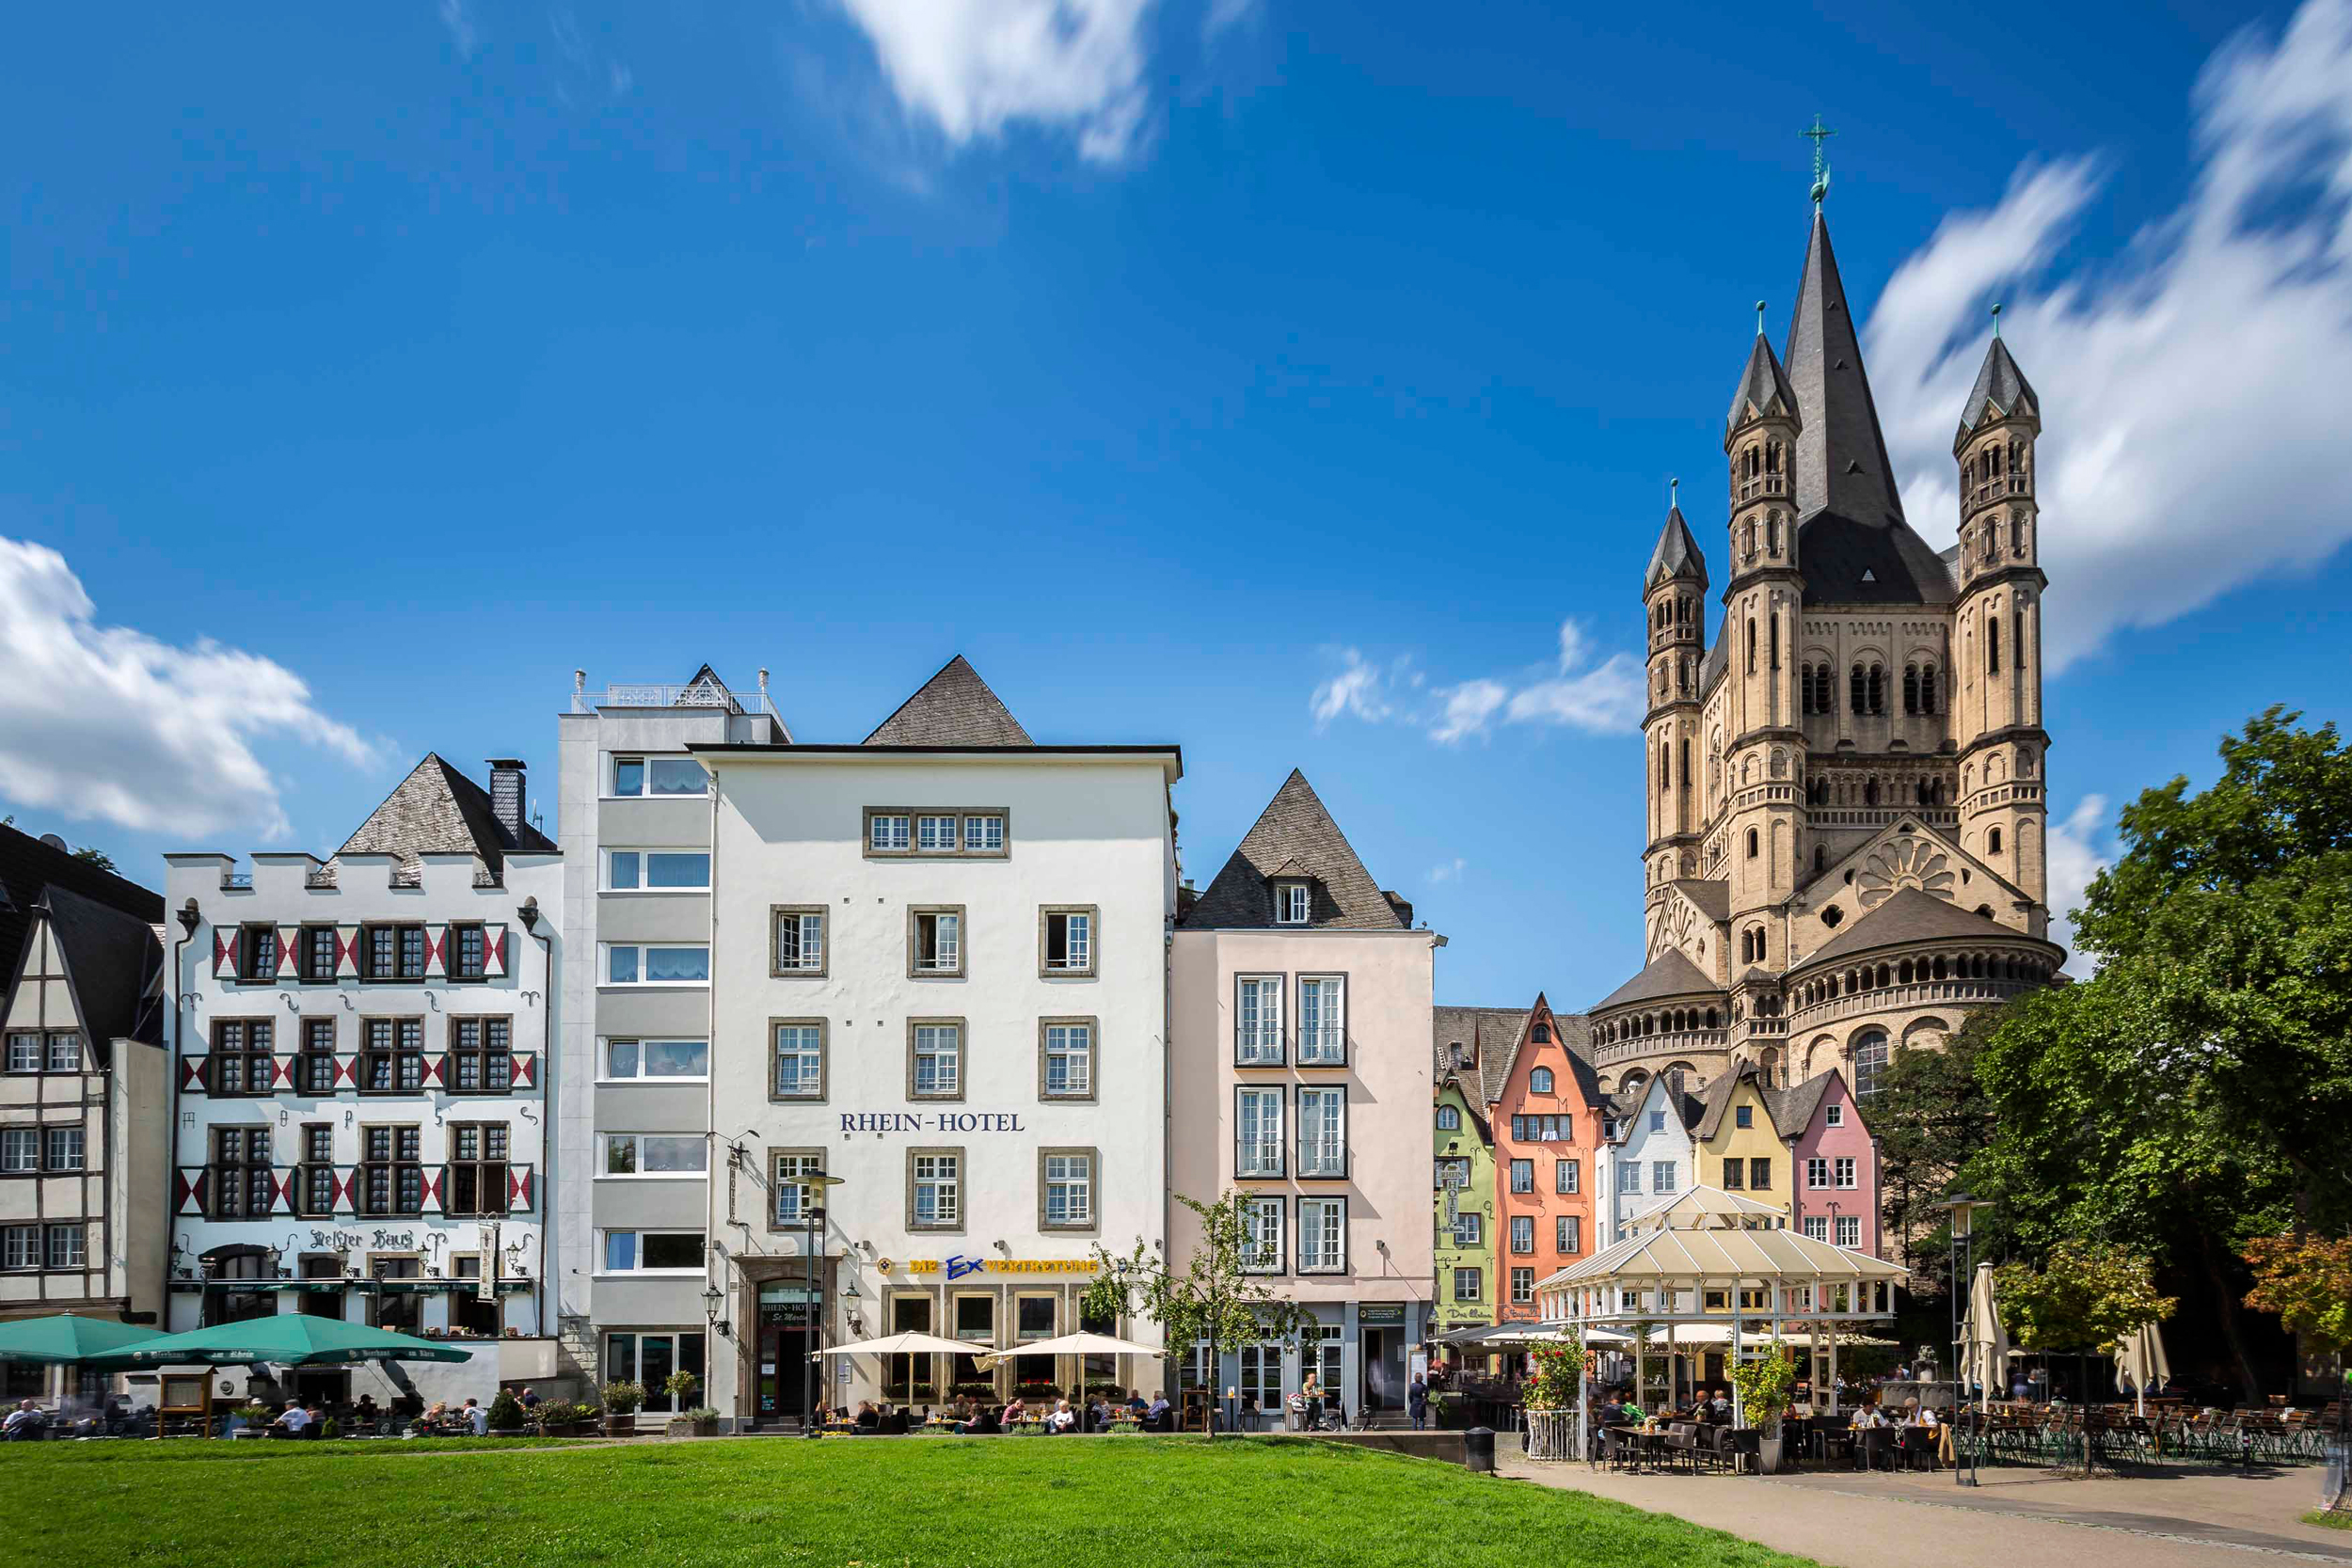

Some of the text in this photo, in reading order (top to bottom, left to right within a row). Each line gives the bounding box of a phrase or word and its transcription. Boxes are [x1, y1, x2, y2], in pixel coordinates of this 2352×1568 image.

[840, 1113, 1025, 1132] RHEIN-HOTEL
[1448, 1180, 1457, 1223] HOTEL
[371, 1227, 414, 1250] Haus
[909, 1259, 938, 1273] DIE
